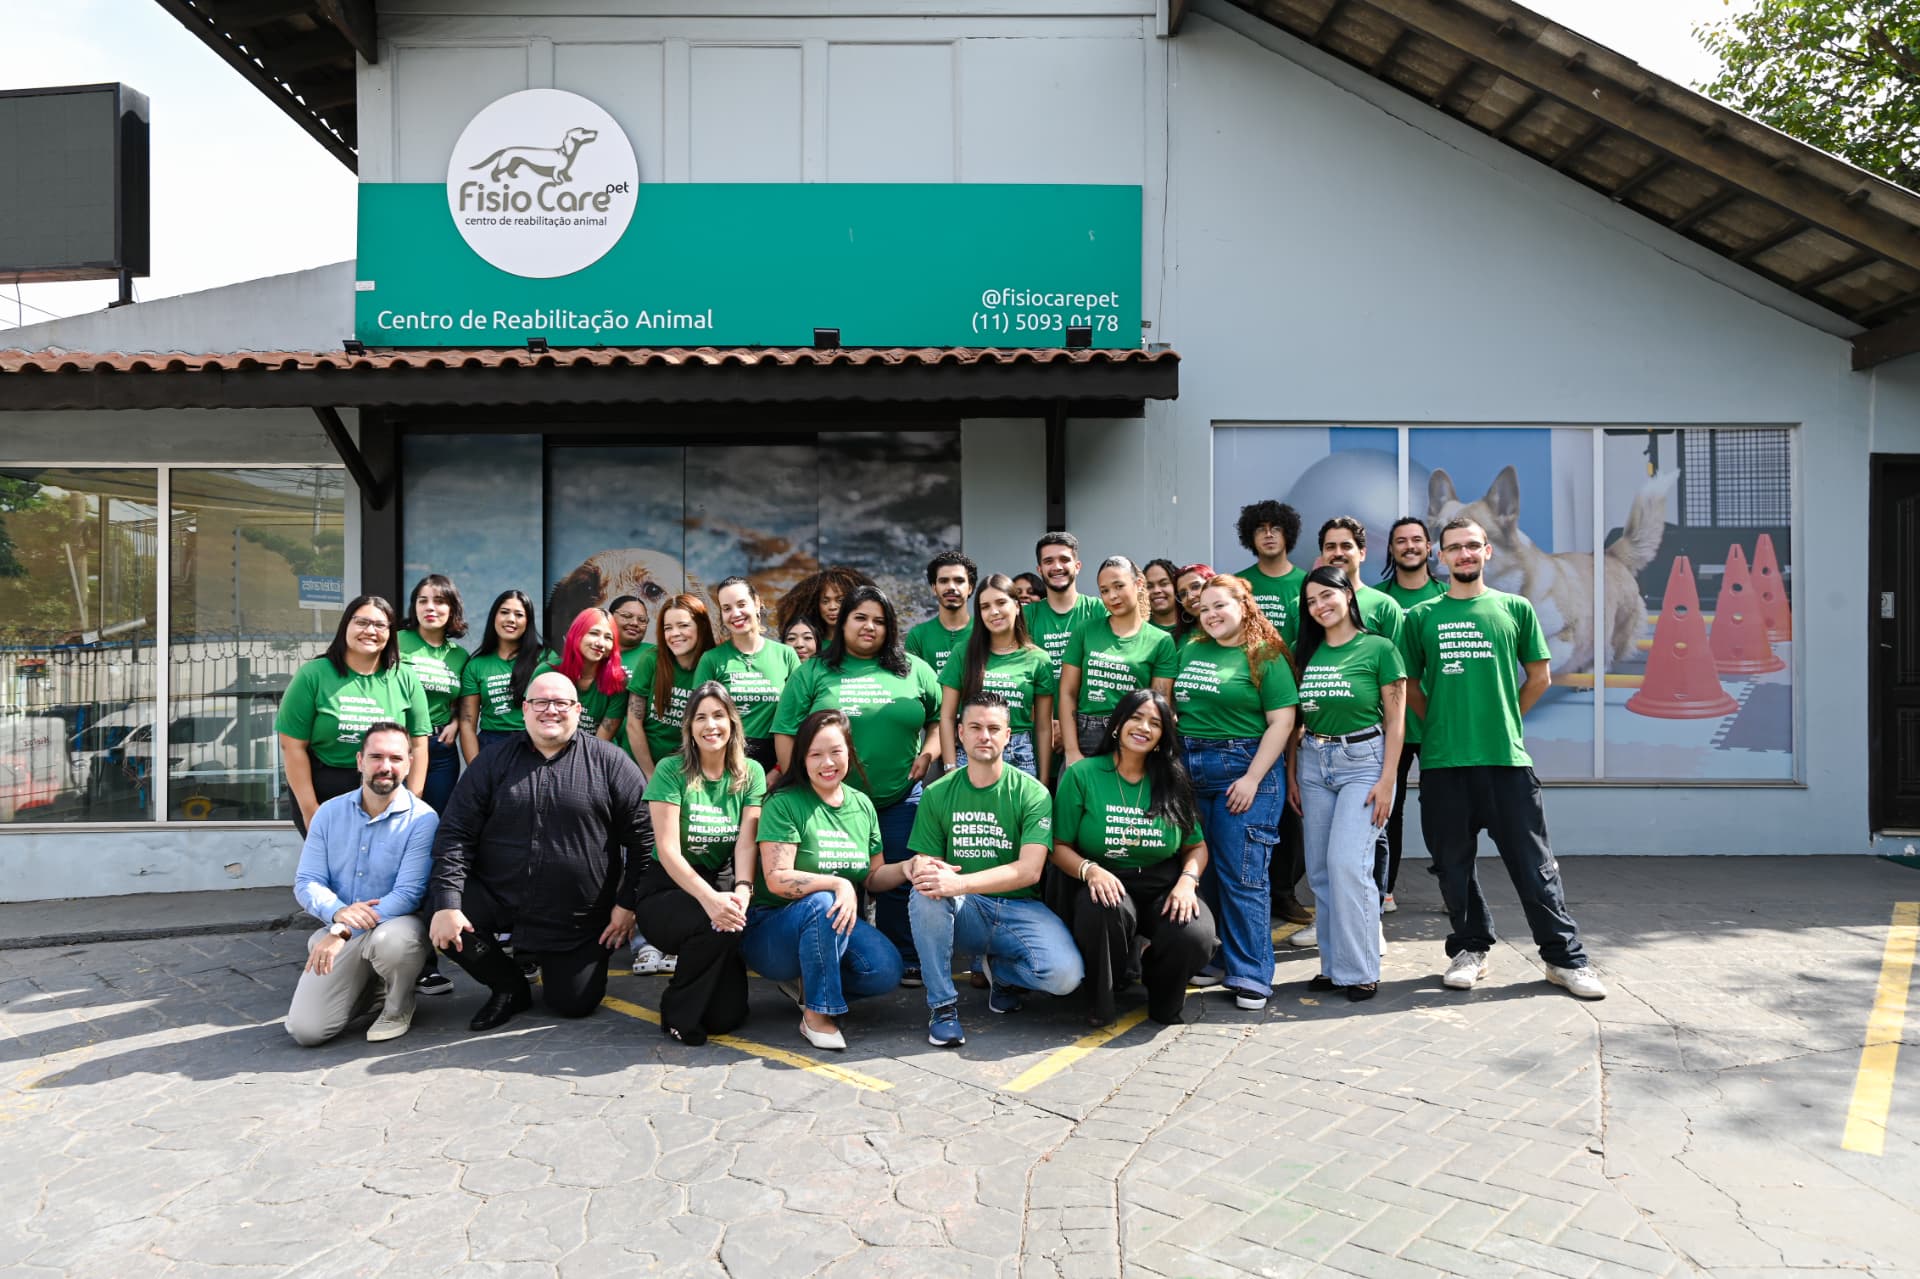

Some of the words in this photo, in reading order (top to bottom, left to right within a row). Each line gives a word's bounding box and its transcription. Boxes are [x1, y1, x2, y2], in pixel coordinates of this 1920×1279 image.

[606, 182, 629, 194] pet
[459, 181, 532, 212] Fisio
[537, 182, 610, 212] Care
[465, 217, 496, 226] centro
[499, 216, 512, 226] de
[515, 216, 571, 227] reabilitação
[574, 217, 607, 226] animal
[981, 288, 1119, 311] @fisiocarepet
[377, 310, 453, 330] Centro
[459, 309, 487, 330] de
[493, 309, 628, 334] Reabilitação
[635, 309, 714, 330] Animal
[972, 311, 1009, 334] (11)
[1015, 313, 1063, 331] 5093
[1440, 651, 1472, 660] NOSSO
[1087, 679, 1115, 689] NOSSO
[1328, 689, 1355, 698] DNA.
[1106, 804, 1144, 816] INOVAR;
[952, 812, 998, 825] INOVAR,
[1105, 815, 1153, 826] CRESCER;
[952, 824, 1007, 839] CRESCER,
[687, 835, 720, 843] NOSSO
[952, 837, 1013, 850] MELHORAR:
[1142, 839, 1166, 847] DNA.
[953, 849, 981, 858] NOSSO
[818, 861, 850, 869] NOSSO
